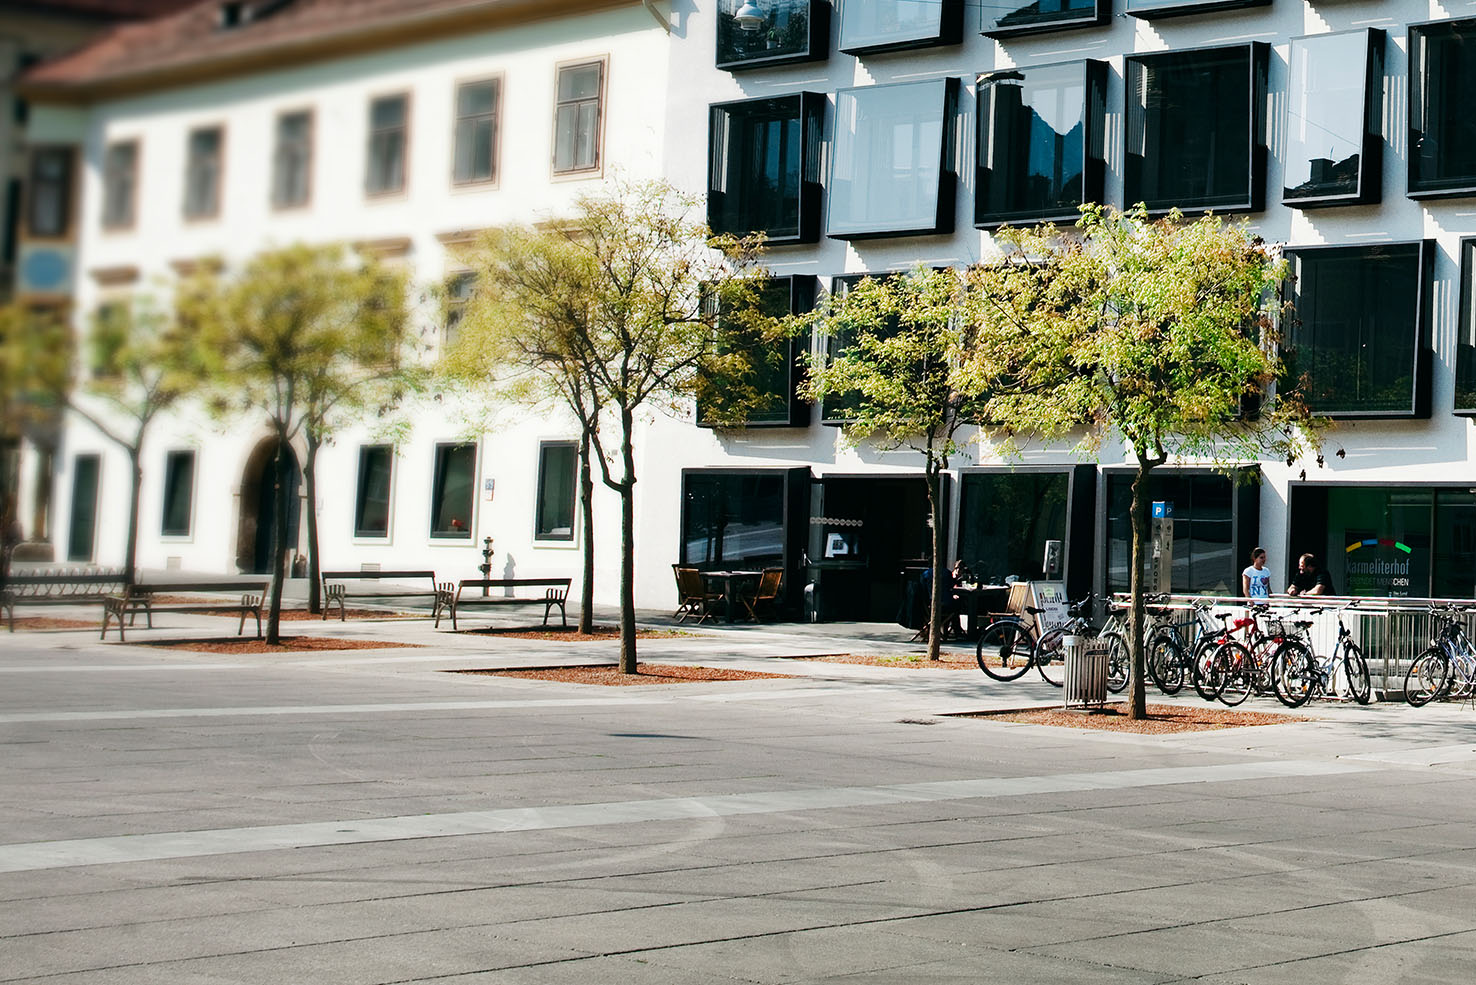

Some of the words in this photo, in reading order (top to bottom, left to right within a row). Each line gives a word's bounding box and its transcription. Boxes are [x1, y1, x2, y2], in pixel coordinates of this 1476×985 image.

[1155, 506, 1162, 515] P
[1166, 507, 1172, 516] P
[1252, 576, 1258, 586] I
[1251, 586, 1267, 596] NY
